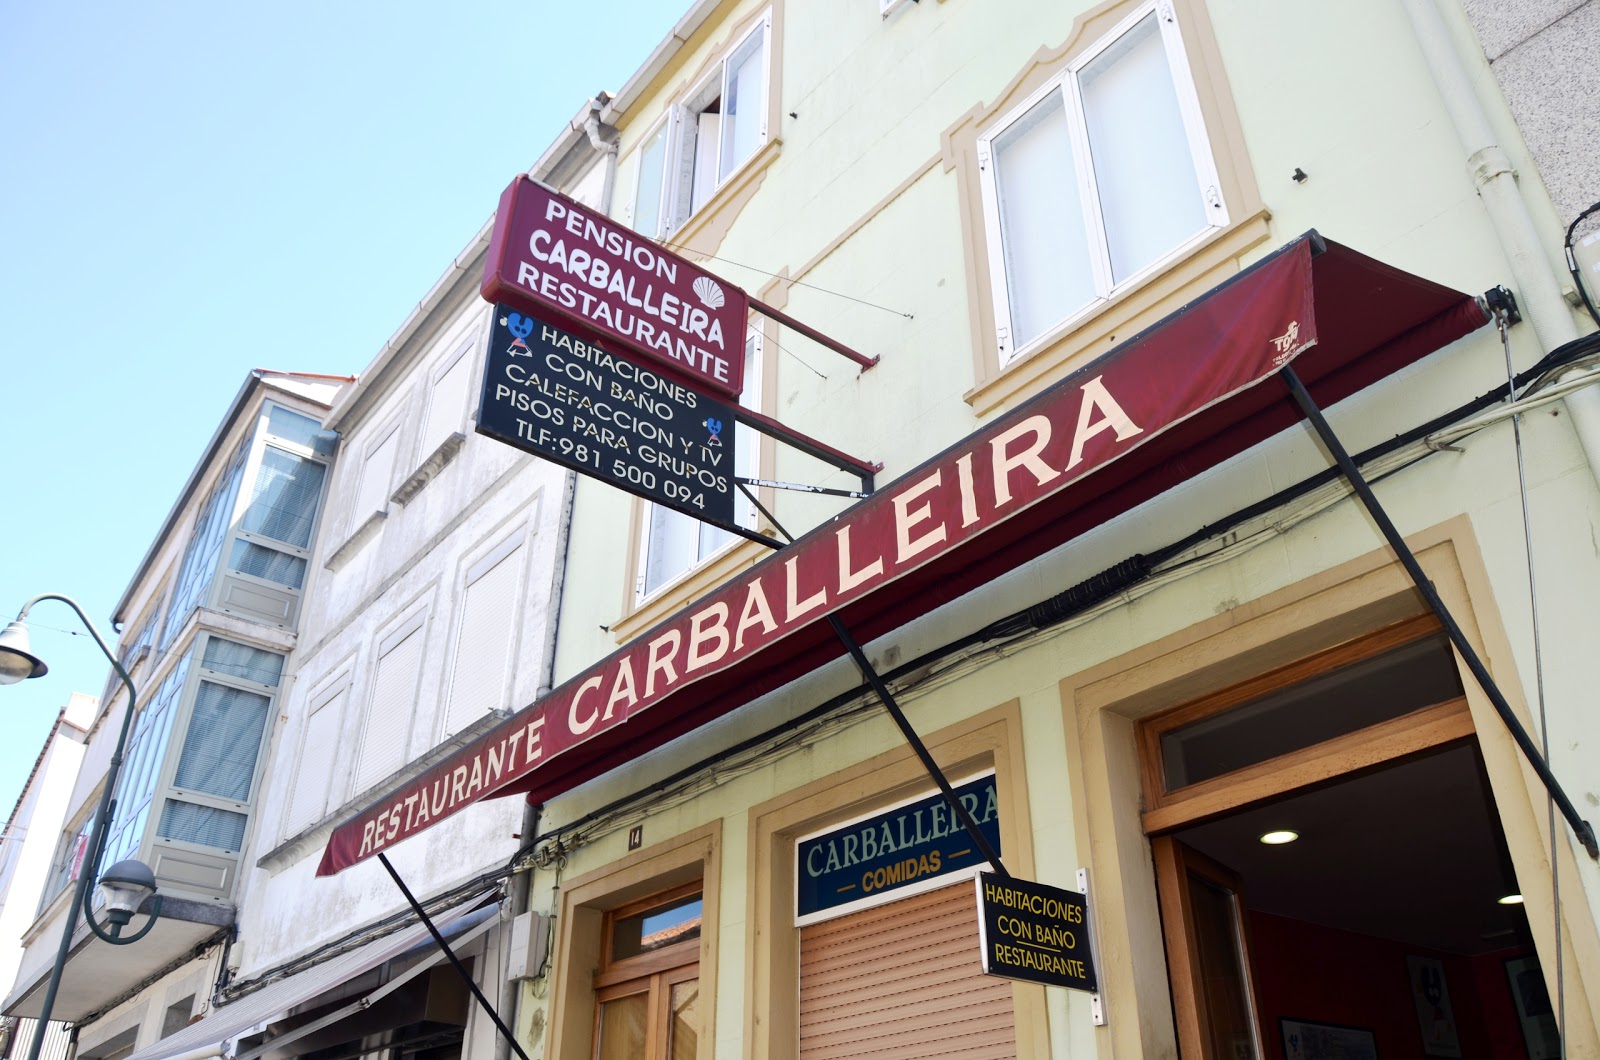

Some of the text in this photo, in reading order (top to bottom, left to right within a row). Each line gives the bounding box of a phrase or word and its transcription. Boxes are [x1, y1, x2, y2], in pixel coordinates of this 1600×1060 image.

[545, 198, 677, 284] PENSION
[517, 260, 729, 383] RESTAURANTE
[529, 229, 725, 350] CARBALLEIRA
[541, 325, 697, 408] HABITACIONES
[545, 353, 674, 421] CON BAÑO
[495, 384, 728, 493] PISOS PARA GRUPOS
[505, 363, 722, 467] CALEFACCION Y TV
[612, 459, 656, 490] 500
[663, 480, 705, 509] 094
[358, 374, 1144, 858] RESTAURANTE CARBALLEIRA
[631, 829, 640, 846] 14
[861, 850, 942, 892] COMIDAS
[985, 883, 1082, 924] HABITACIONES
[997, 915, 1076, 950] CON BAÑO
[995, 943, 1086, 979] RESTAURANTE
